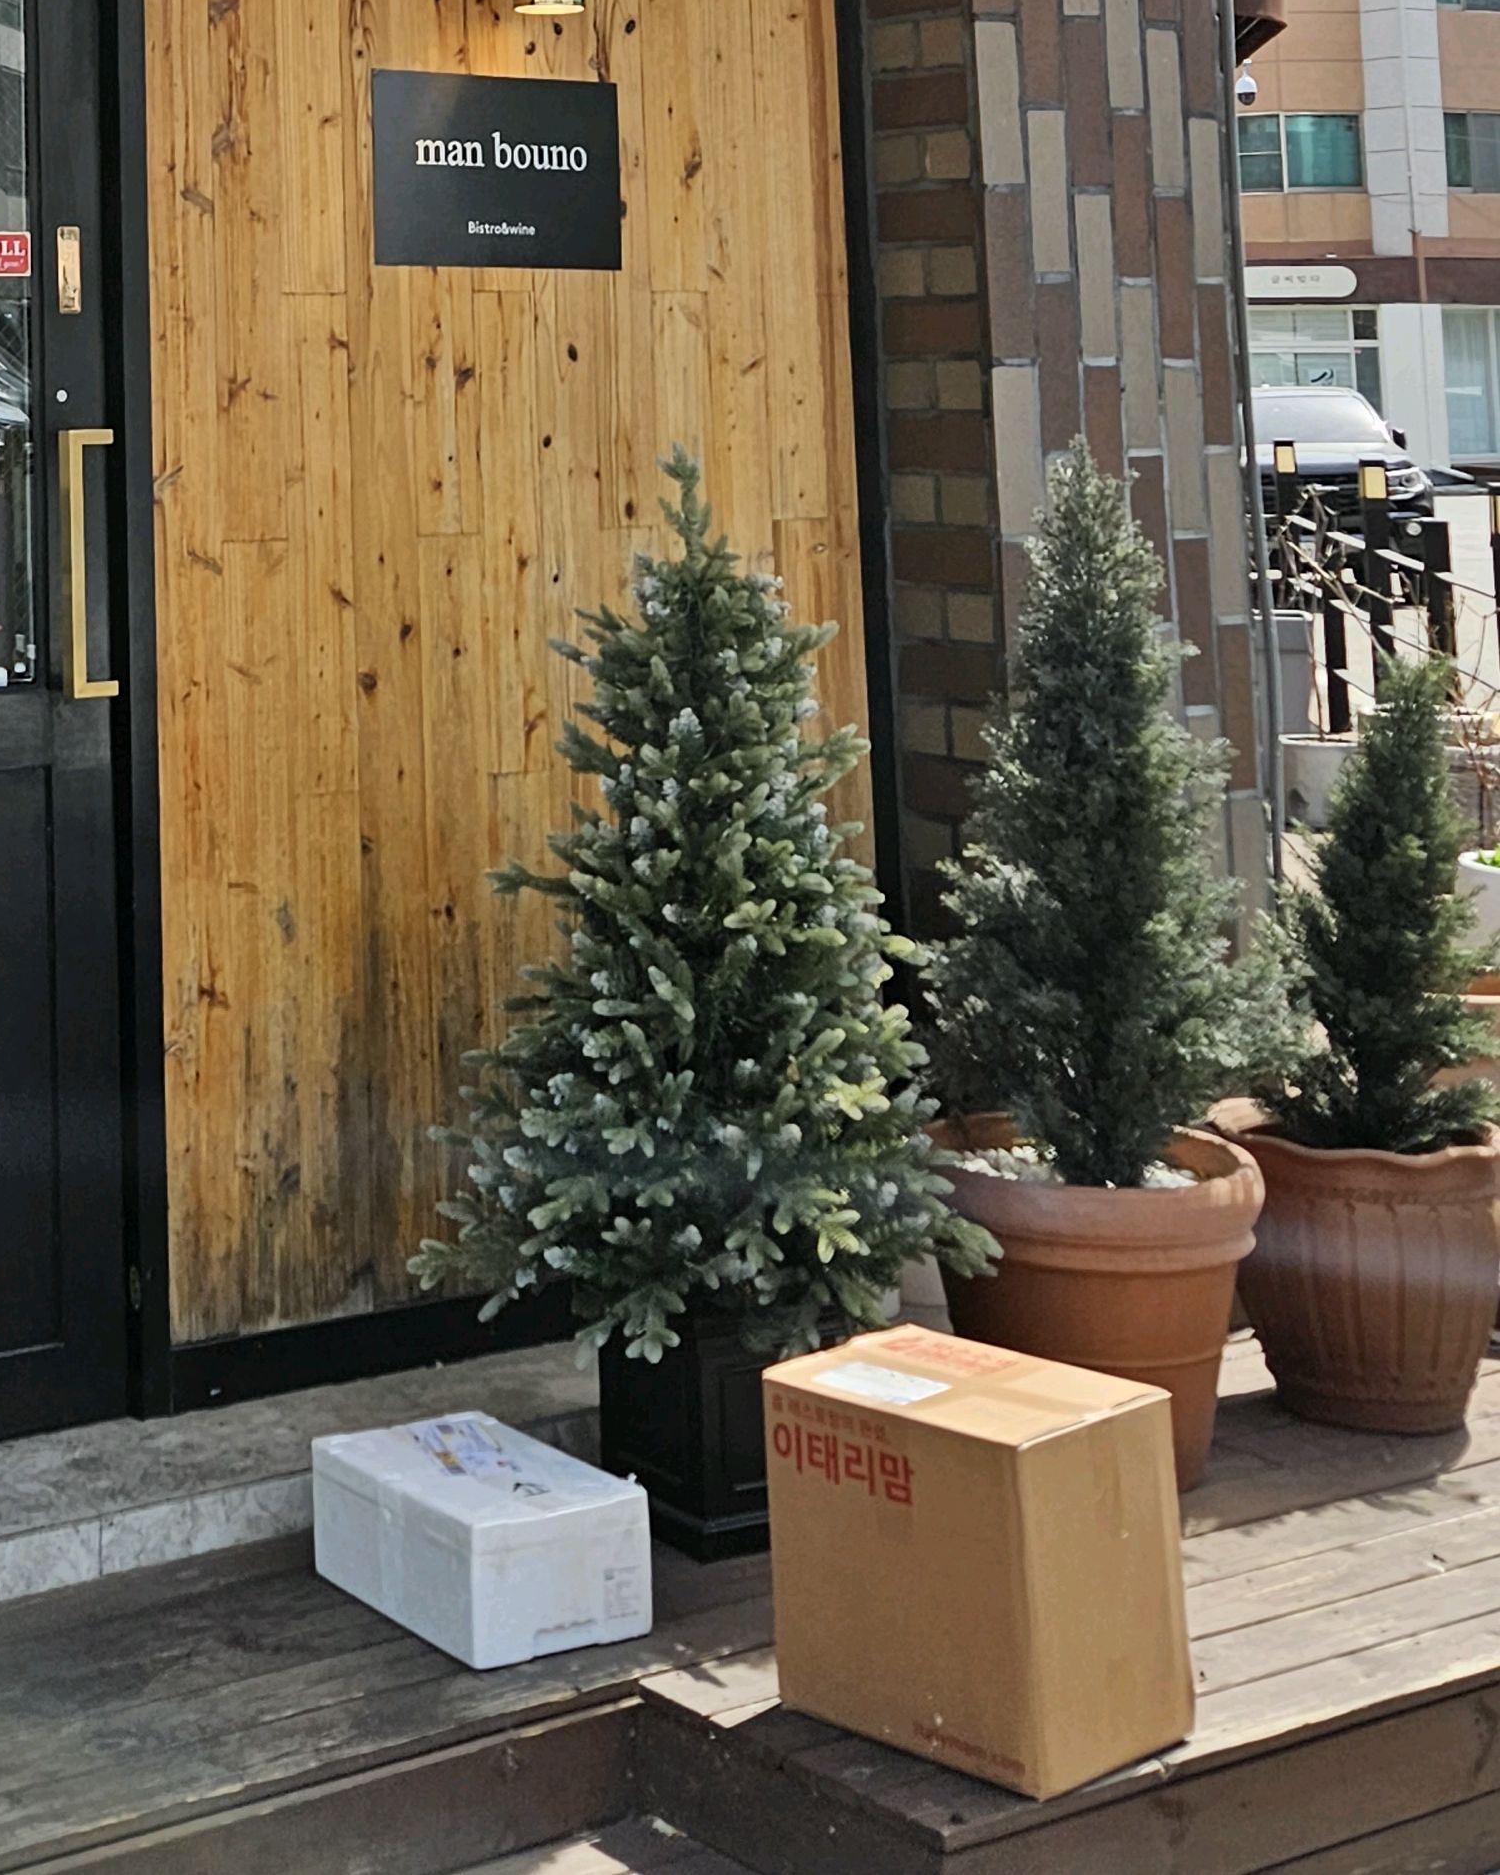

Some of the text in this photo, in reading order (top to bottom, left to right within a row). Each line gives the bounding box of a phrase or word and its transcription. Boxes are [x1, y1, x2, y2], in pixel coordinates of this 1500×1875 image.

[414, 131, 588, 172] man bouno
[467, 220, 536, 236] Bistro&wine
[773, 1421, 915, 1505] 이태리맘
